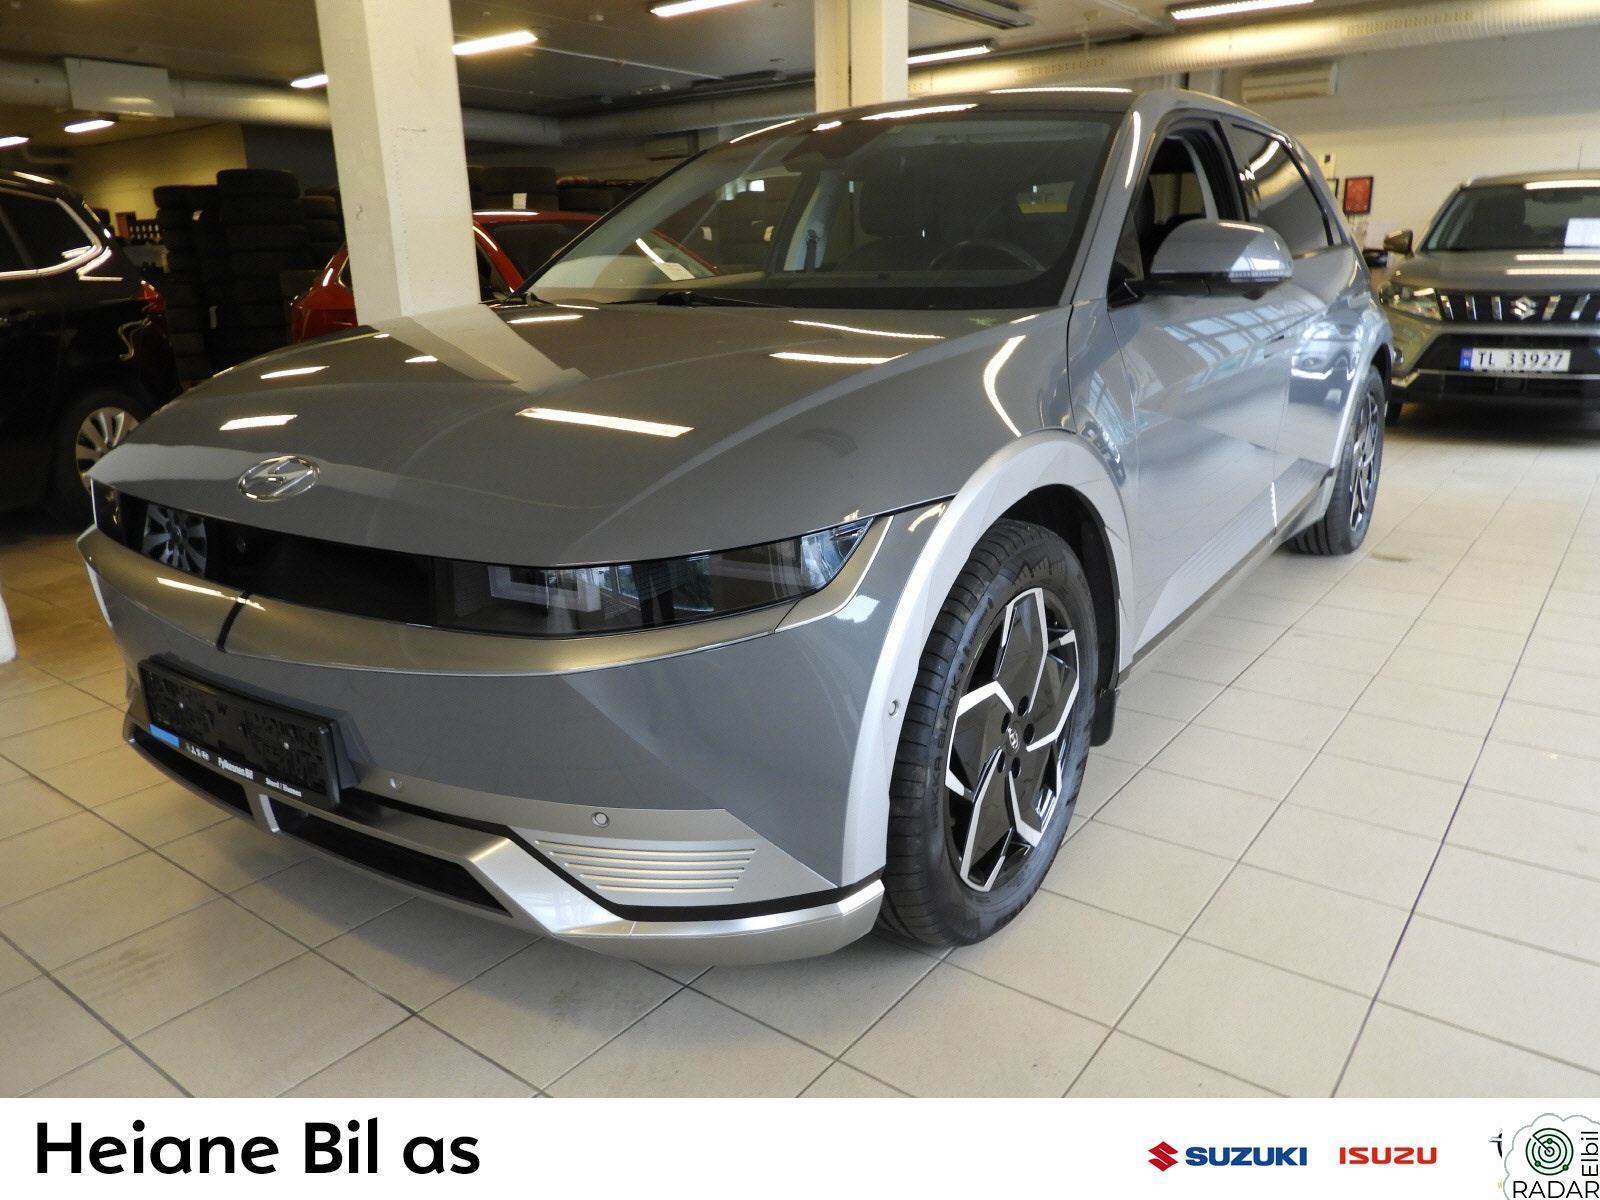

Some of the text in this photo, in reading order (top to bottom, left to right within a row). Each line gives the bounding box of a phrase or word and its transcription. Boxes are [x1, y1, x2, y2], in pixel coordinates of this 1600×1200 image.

[1478, 351, 1495, 367] TL
[1506, 352, 1563, 368] 33927
[937, 679, 960, 750] BLACK
